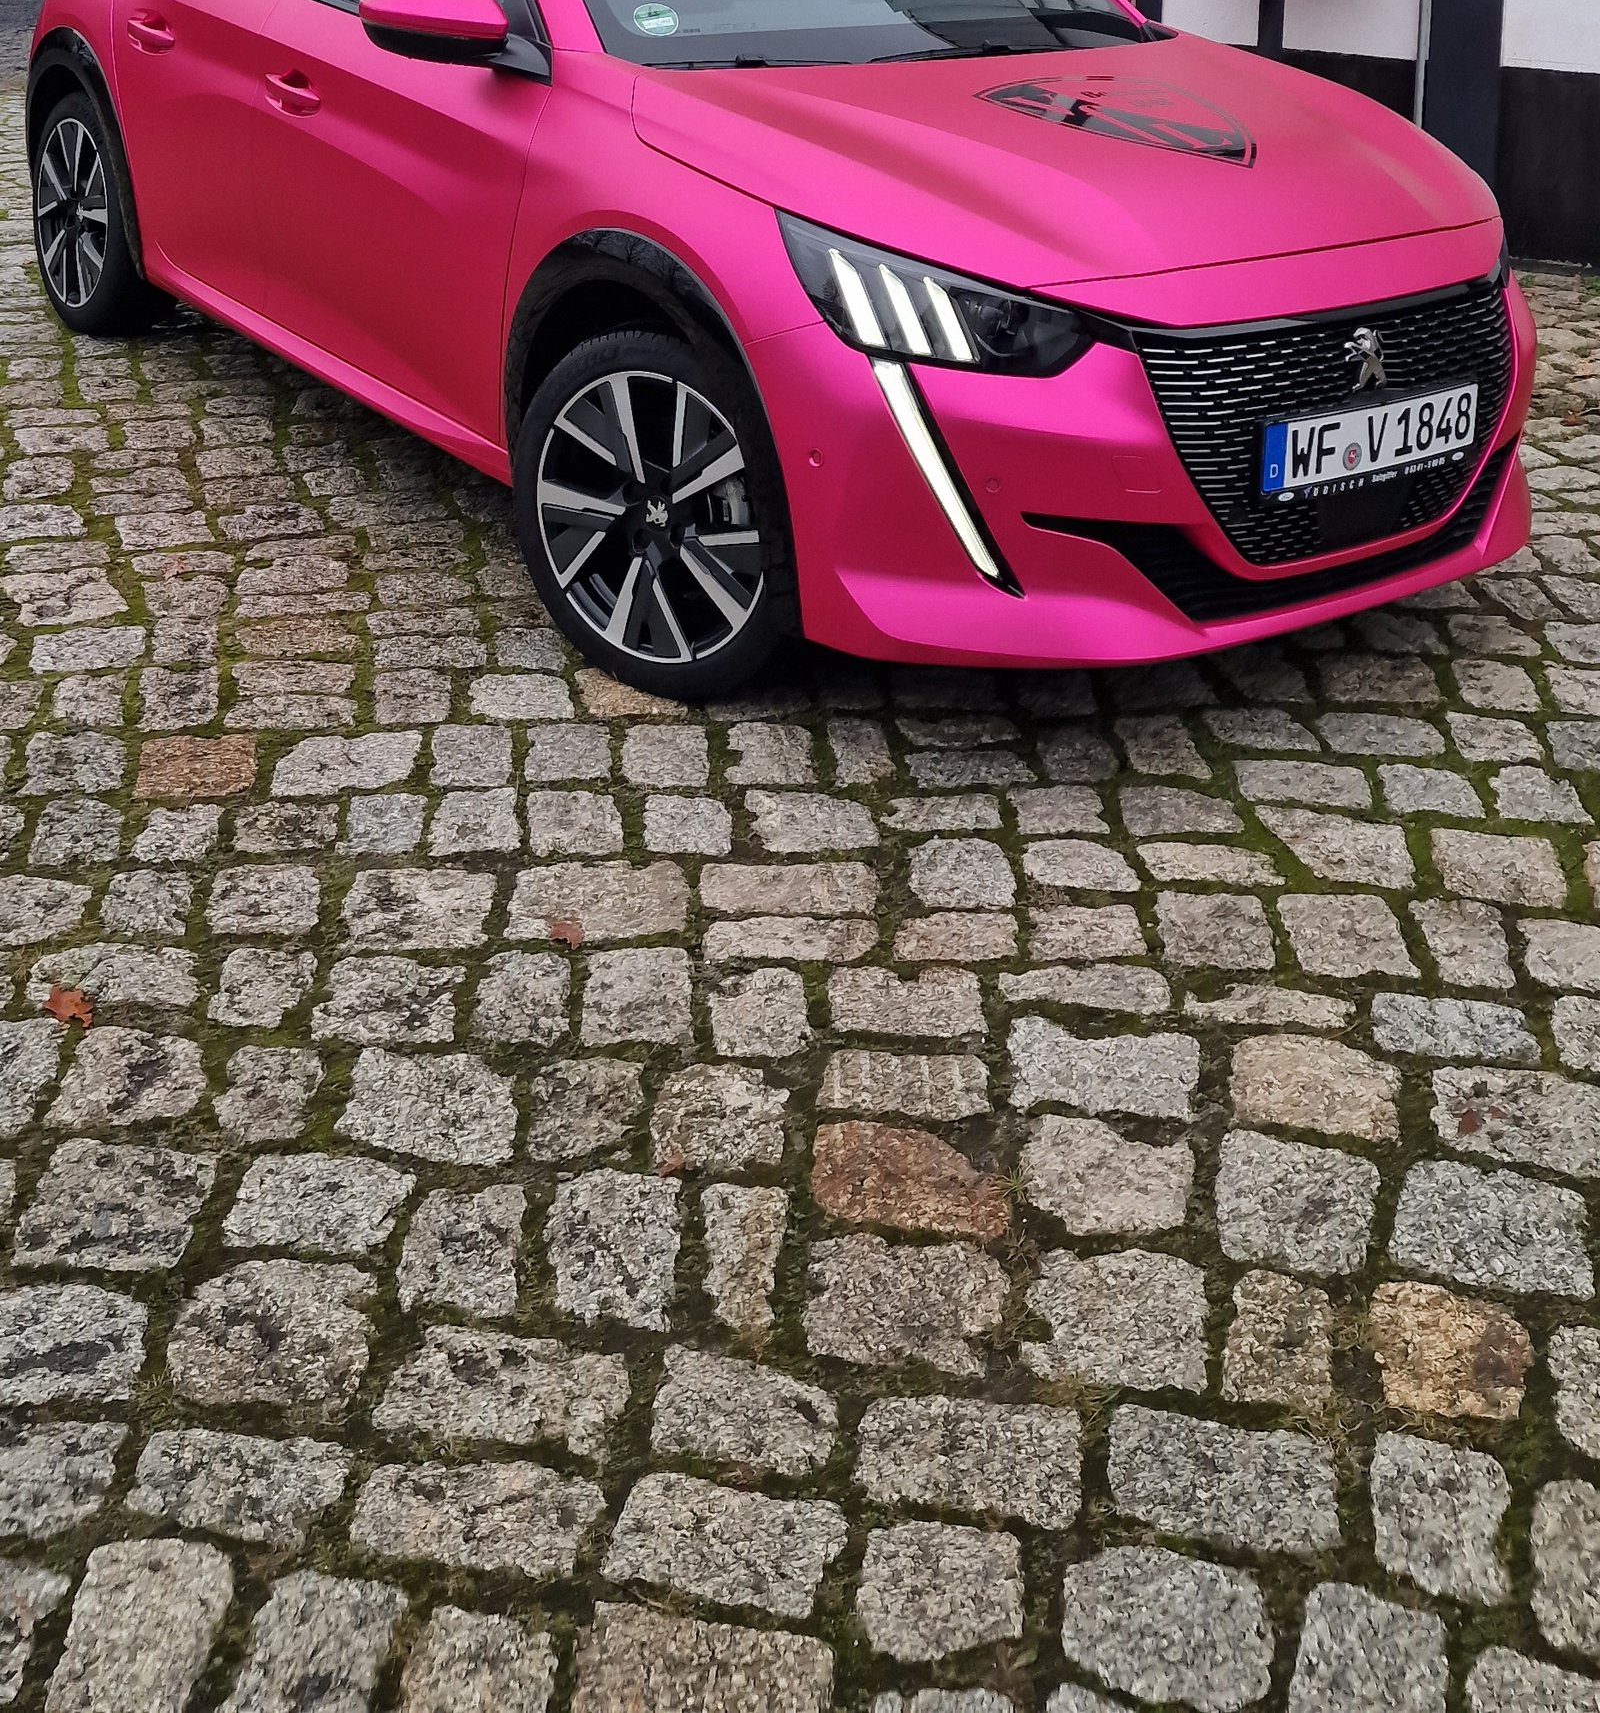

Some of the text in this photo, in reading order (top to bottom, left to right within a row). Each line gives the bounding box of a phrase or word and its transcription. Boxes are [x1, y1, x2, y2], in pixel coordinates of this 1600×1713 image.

[1269, 392, 1473, 479] D WF V 1848
